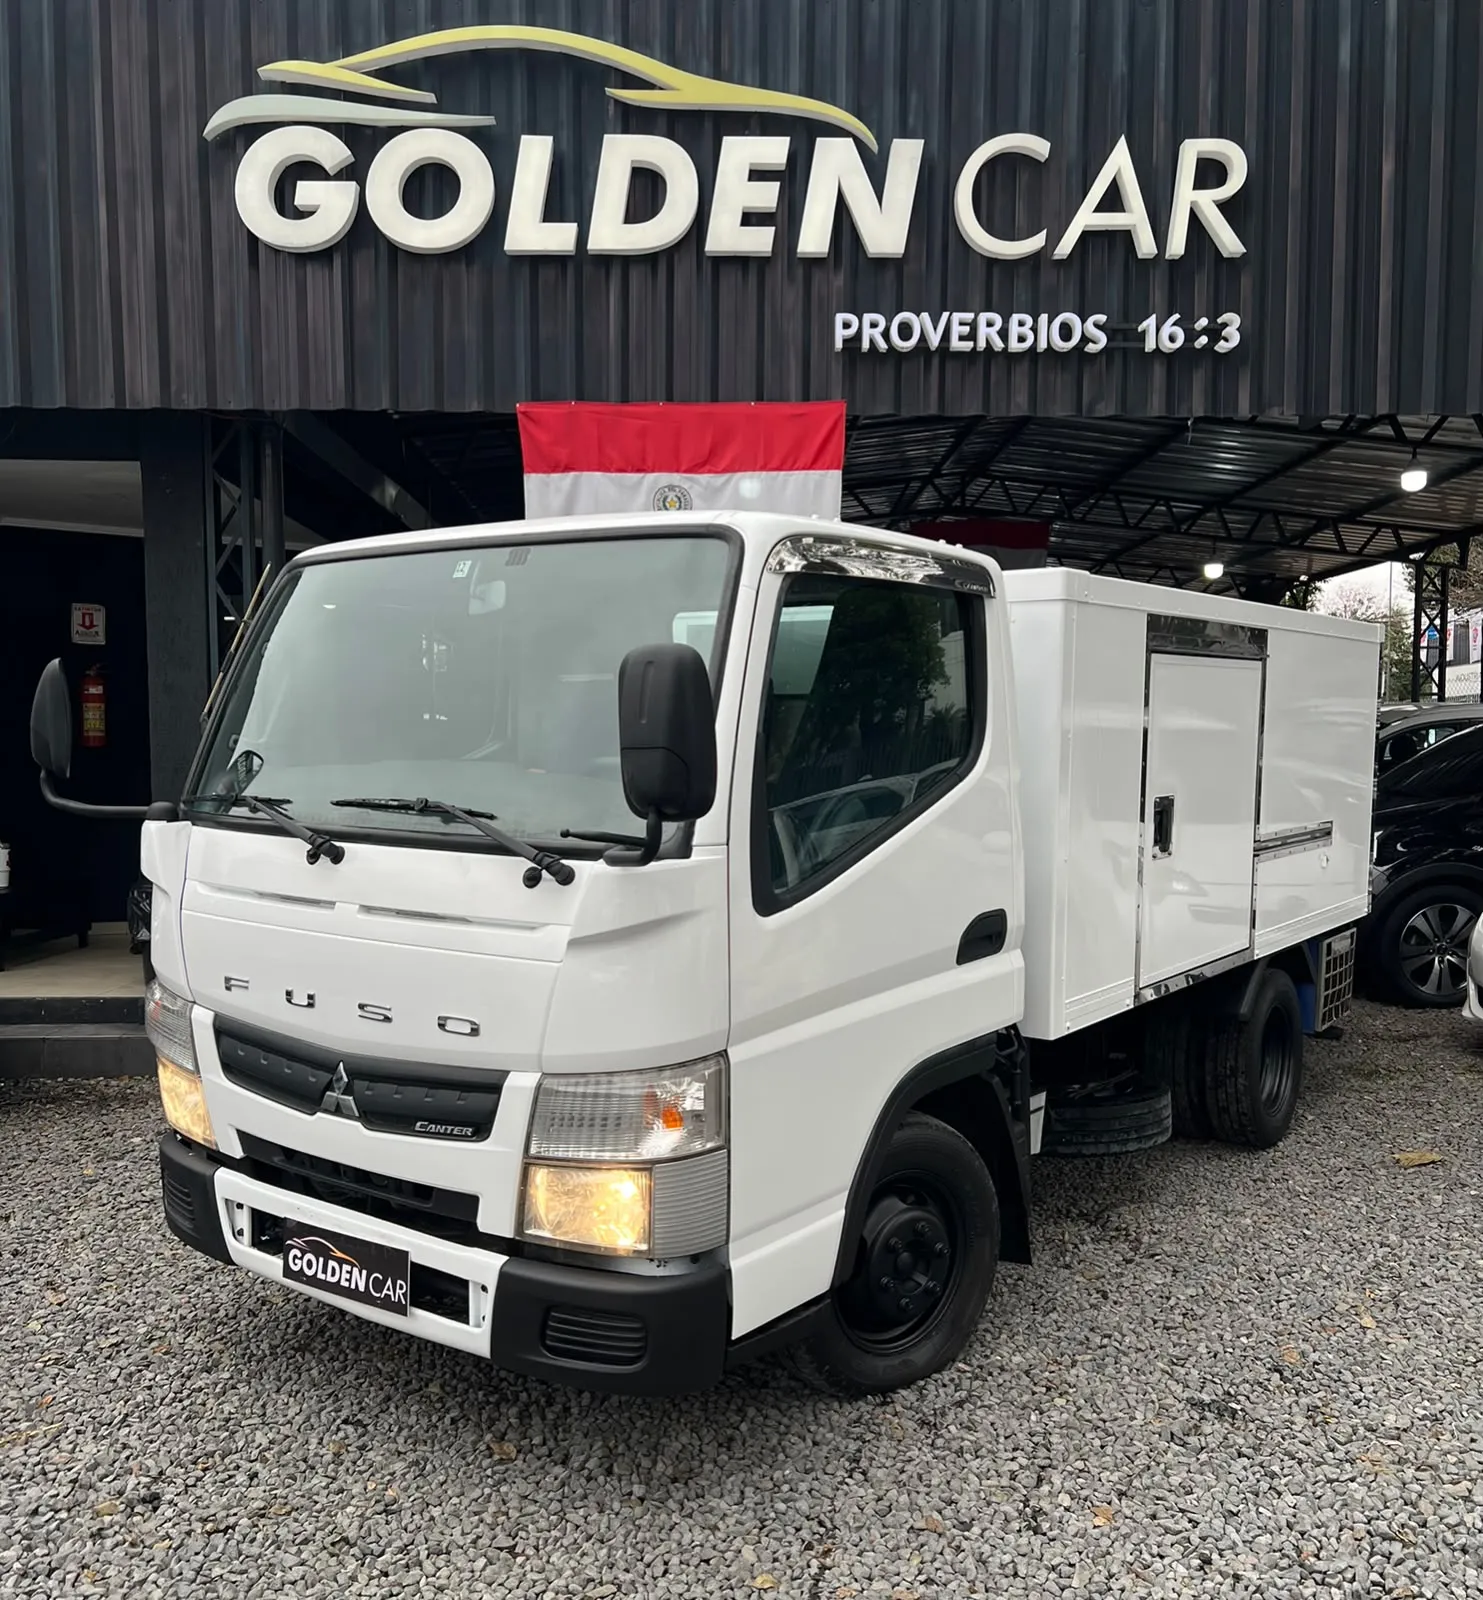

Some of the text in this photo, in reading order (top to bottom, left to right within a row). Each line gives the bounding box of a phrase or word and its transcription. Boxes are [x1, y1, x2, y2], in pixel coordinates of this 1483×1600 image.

[234, 125, 1248, 260] GOLDEN CAR
[834, 311, 1242, 353] PROVERBIOS 16:3
[224, 975, 481, 1037] FUSO
[414, 1121, 473, 1136] CANTER
[288, 1248, 407, 1305] GOLDEN CAR
